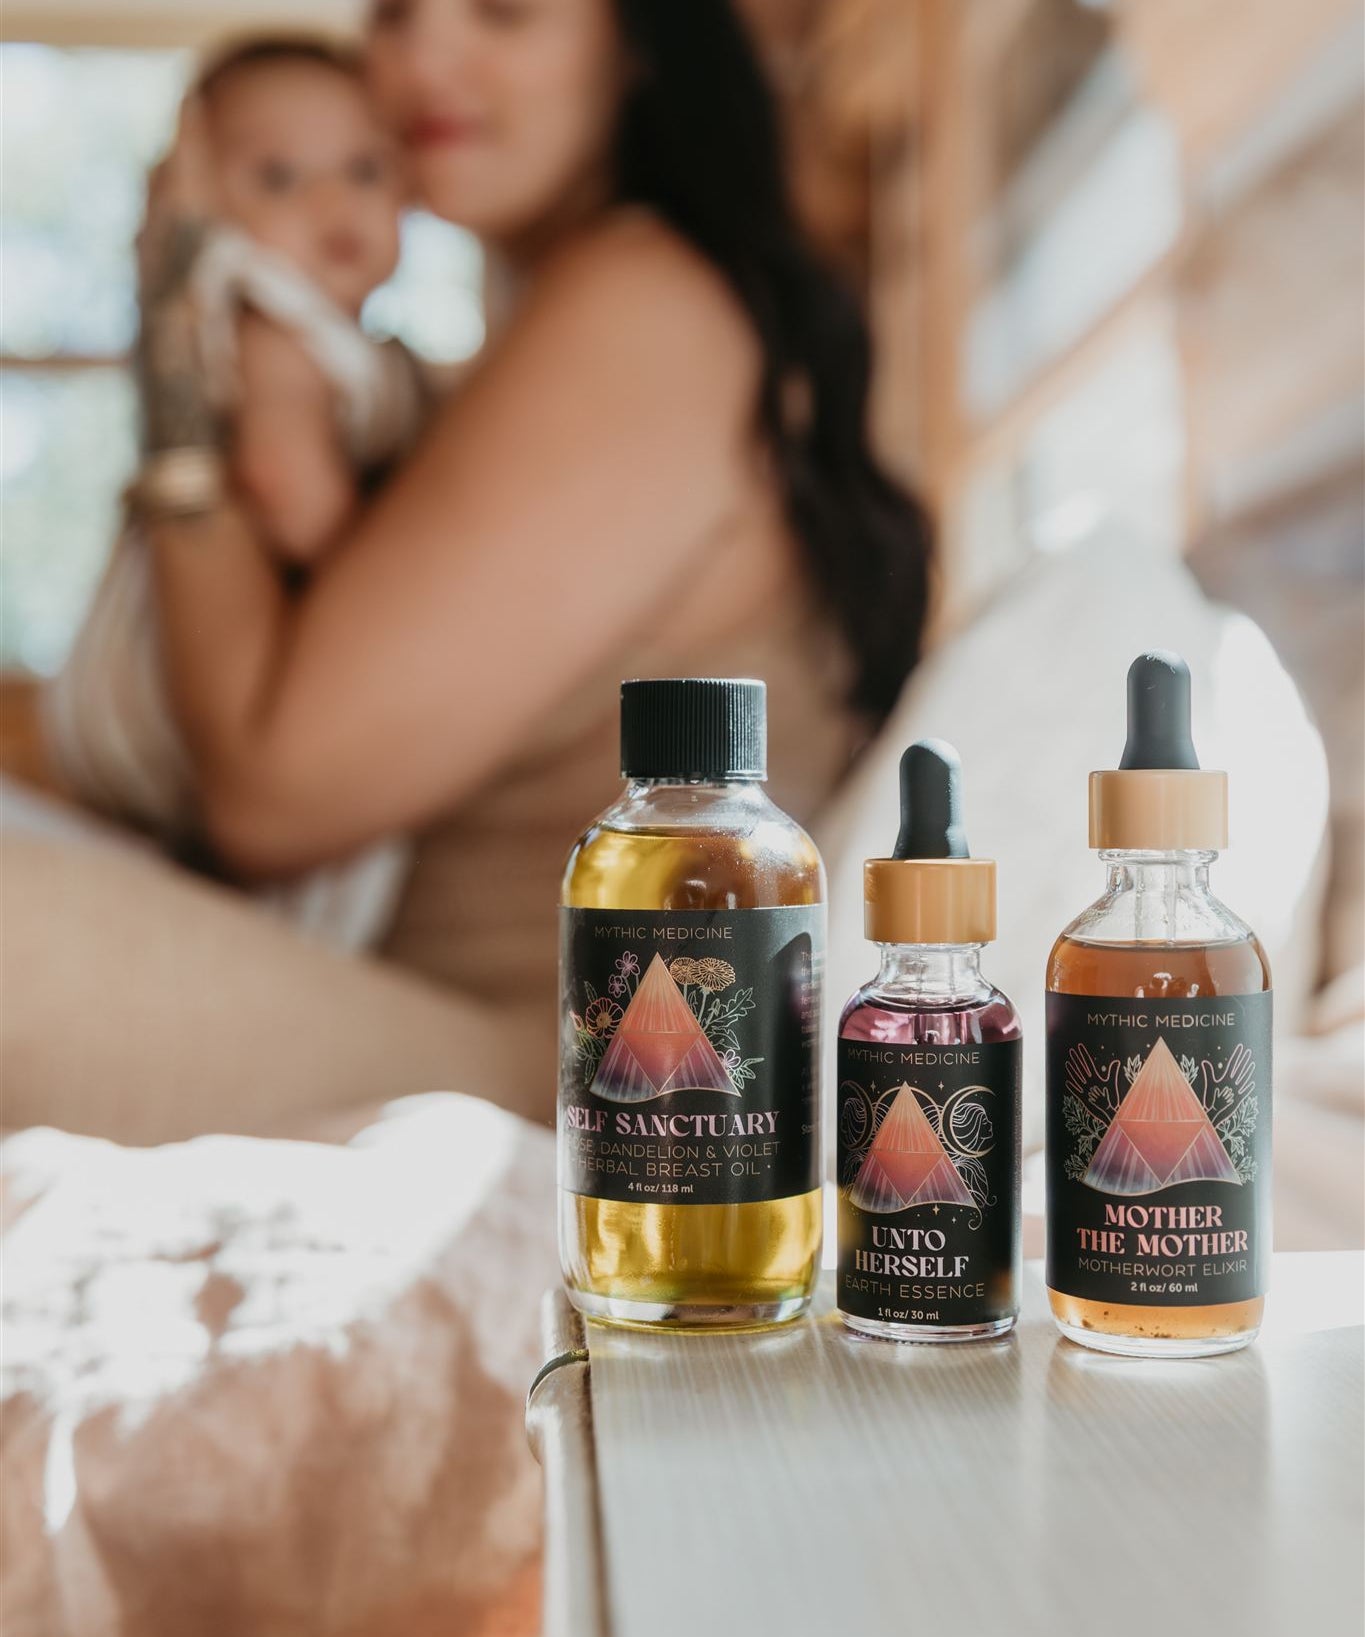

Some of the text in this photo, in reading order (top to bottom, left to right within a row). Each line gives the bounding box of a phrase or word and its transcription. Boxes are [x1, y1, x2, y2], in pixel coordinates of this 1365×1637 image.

[594, 926, 733, 940] MYTHIC MEDICINE
[1087, 1012, 1236, 1028] MYTHIC MEDICINE
[847, 1047, 981, 1065] MYTHIC MEDICINE
[567, 1104, 608, 1132] SELF
[615, 1111, 780, 1137] SANCTUARY
[600, 1141, 699, 1159] DANDELION
[706, 1145, 717, 1159] &
[722, 1141, 780, 1158] VIOLET
[577, 1156, 761, 1177] HERBAL BREAST OIL
[627, 1182, 694, 1193] 4 fl oz/ 118 ml
[1103, 1204, 1223, 1229] MOTHER
[872, 1225, 946, 1251] UNTO
[1076, 1227, 1248, 1257] THE MOTHER
[855, 1249, 969, 1278] HERSELF
[1078, 1257, 1248, 1277] MOTHERWORT ELIXIR
[845, 1274, 985, 1300] EARTH ESSENCE
[1130, 1281, 1198, 1293] 2 fl oz/ 60 ml
[878, 1307, 939, 1320] 1 fl oz/ 30 ml
